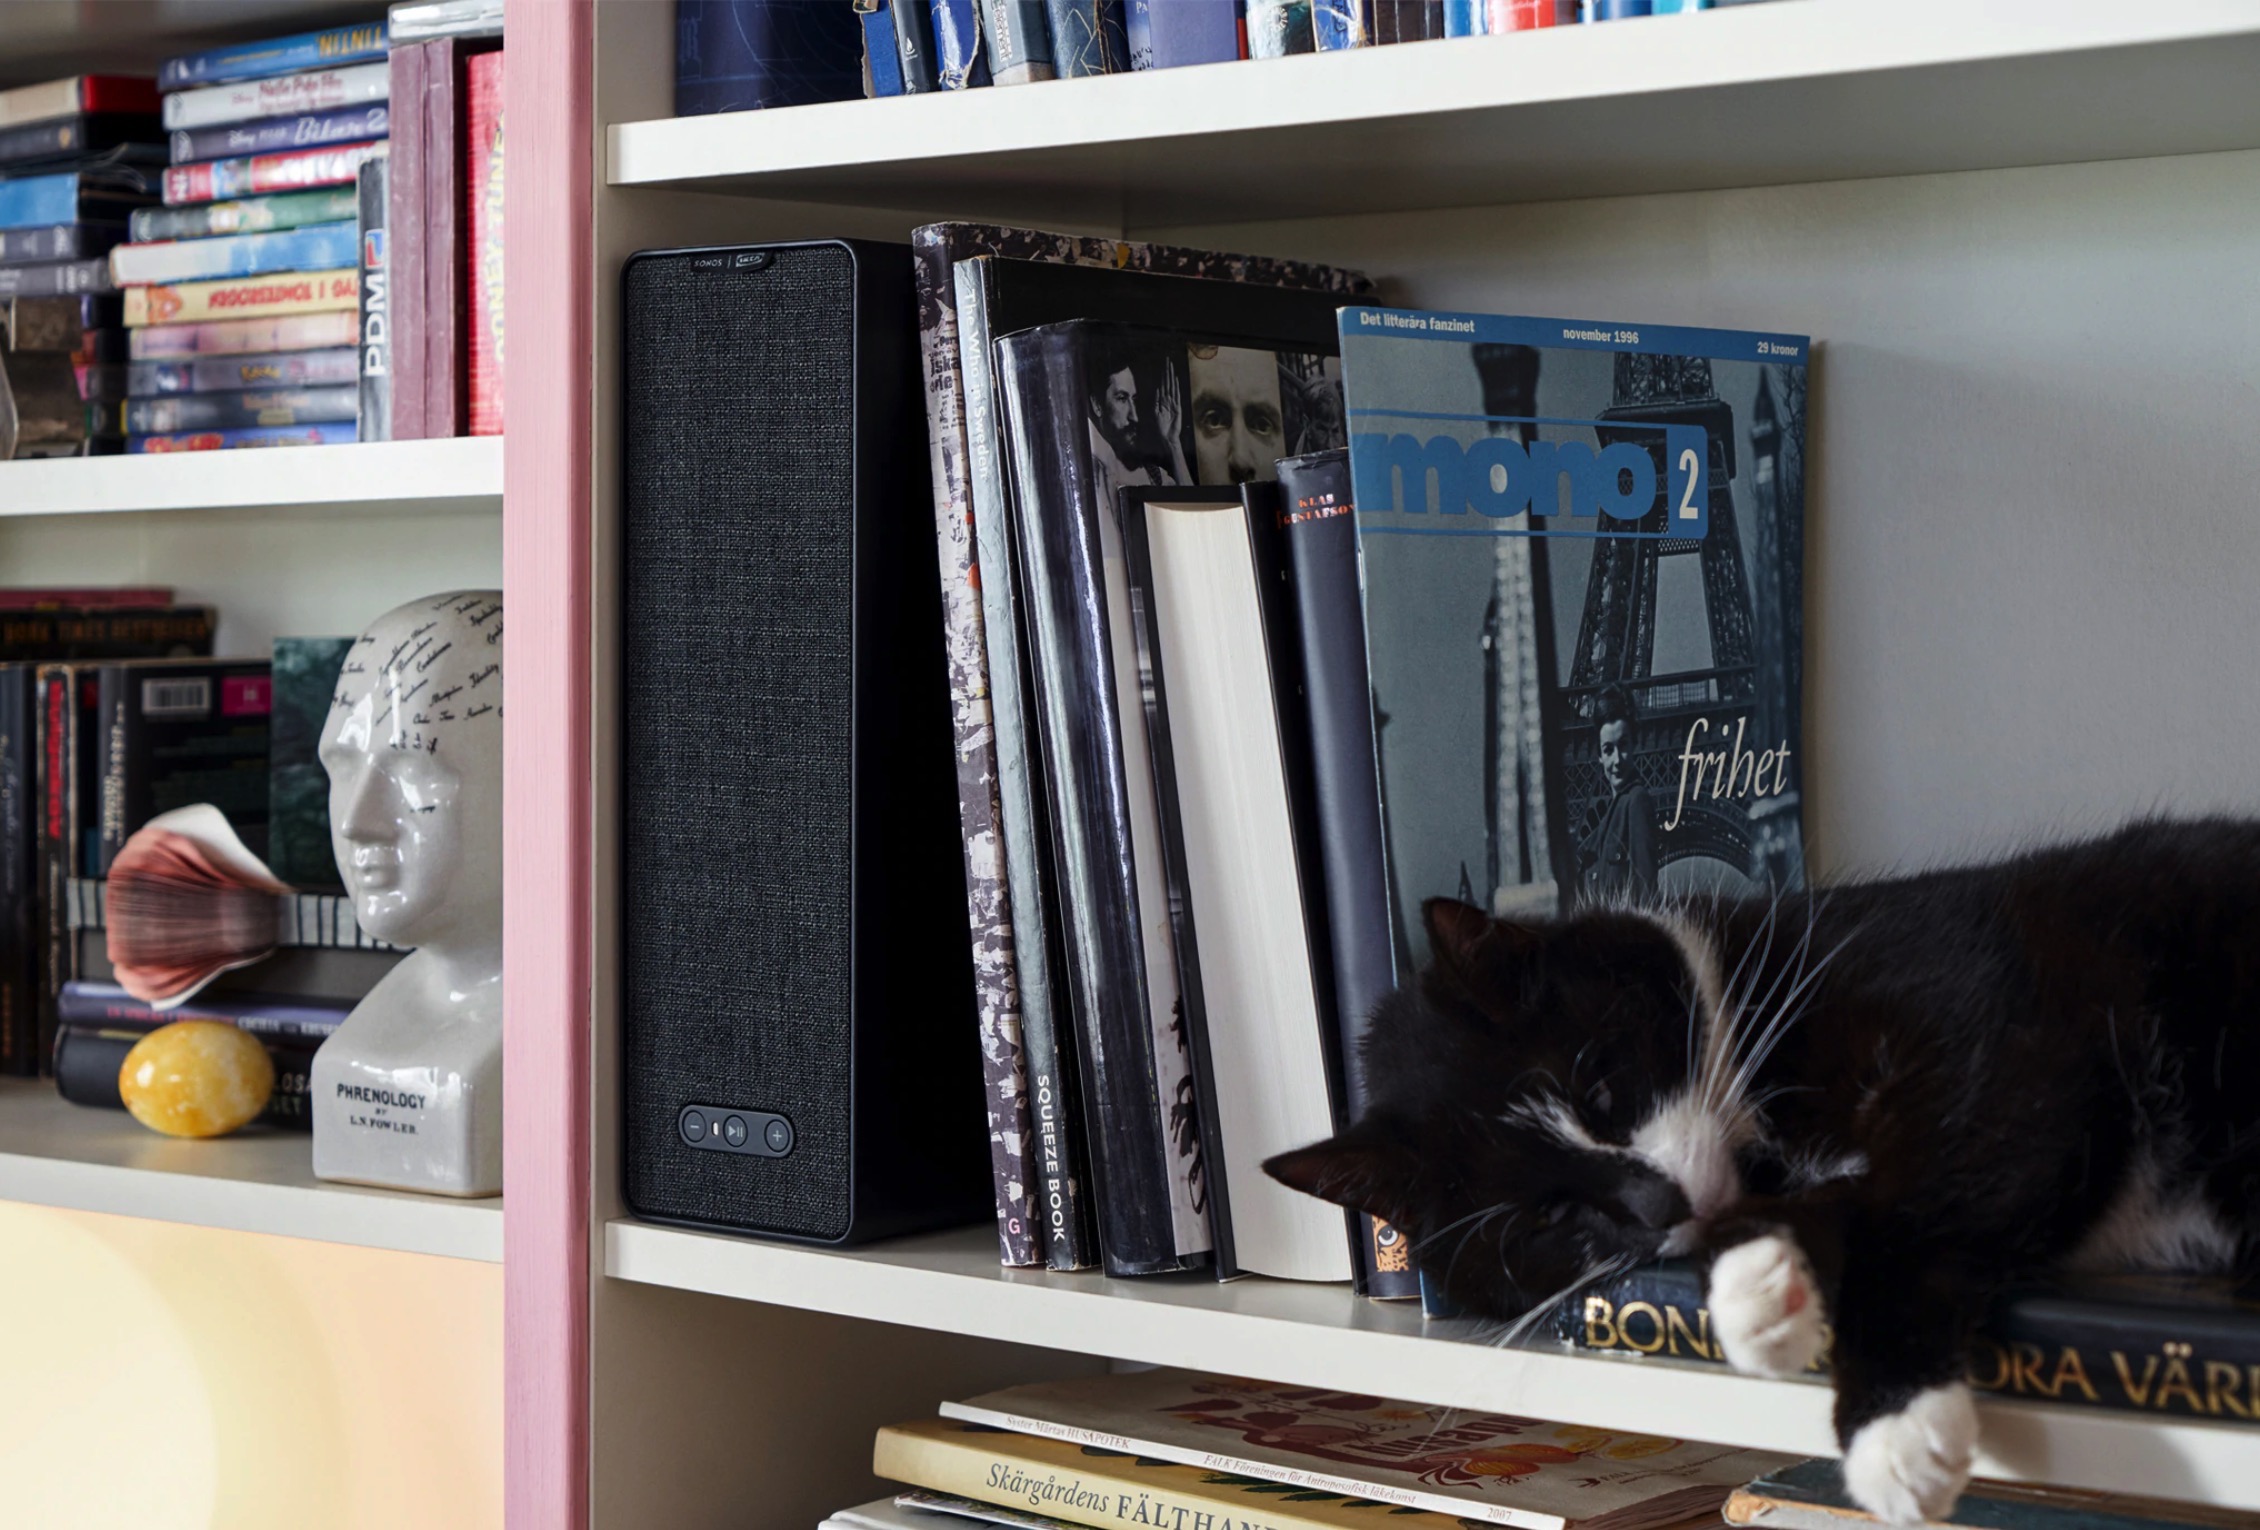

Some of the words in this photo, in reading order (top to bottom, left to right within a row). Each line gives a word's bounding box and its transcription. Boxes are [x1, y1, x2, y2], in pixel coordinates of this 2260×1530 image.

[366, 108, 388, 133] 2
[693, 258, 723, 268] SONOS
[364, 272, 386, 378] PDM
[962, 287, 978, 328] The
[1360, 311, 1381, 326] Det
[1383, 313, 1427, 330] litterära
[1429, 317, 1475, 333] fanzinet
[967, 328, 982, 378] Who
[1563, 327, 1612, 343] november
[1613, 330, 1639, 344] 1996
[1757, 341, 1769, 354] 29
[1770, 341, 1799, 357] kronor
[971, 383, 983, 402] in
[973, 404, 990, 479] Sweden
[1352, 432, 1657, 521] mono
[1677, 447, 1700, 520] 2
[1663, 716, 1791, 832] frihet
[337, 1083, 426, 1110] PHRENOLOGY
[1037, 1074, 1060, 1174] SQUEEZE
[1008, 1217, 1021, 1235] G
[1048, 1177, 1066, 1243] BOOK
[1585, 1296, 1725, 1361] BON
[1966, 1340, 2099, 1401] ORA
[1006, 1415, 1034, 1431] Syster
[1034, 1420, 1066, 1437] Mårtas
[1067, 1427, 1131, 1450] HUSAPOTEK
[1203, 1454, 1233, 1470] FALK
[1233, 1460, 1287, 1481] Föreningen
[1287, 1470, 1304, 1483] för
[1303, 1473, 1369, 1497] Antroposofisk
[1369, 1485, 1417, 1505] läkekonst
[1487, 1506, 1513, 1522] 2007
[986, 1461, 1110, 1514] Skärgårdens
[1115, 1492, 1284, 1530] FÄLTHA
